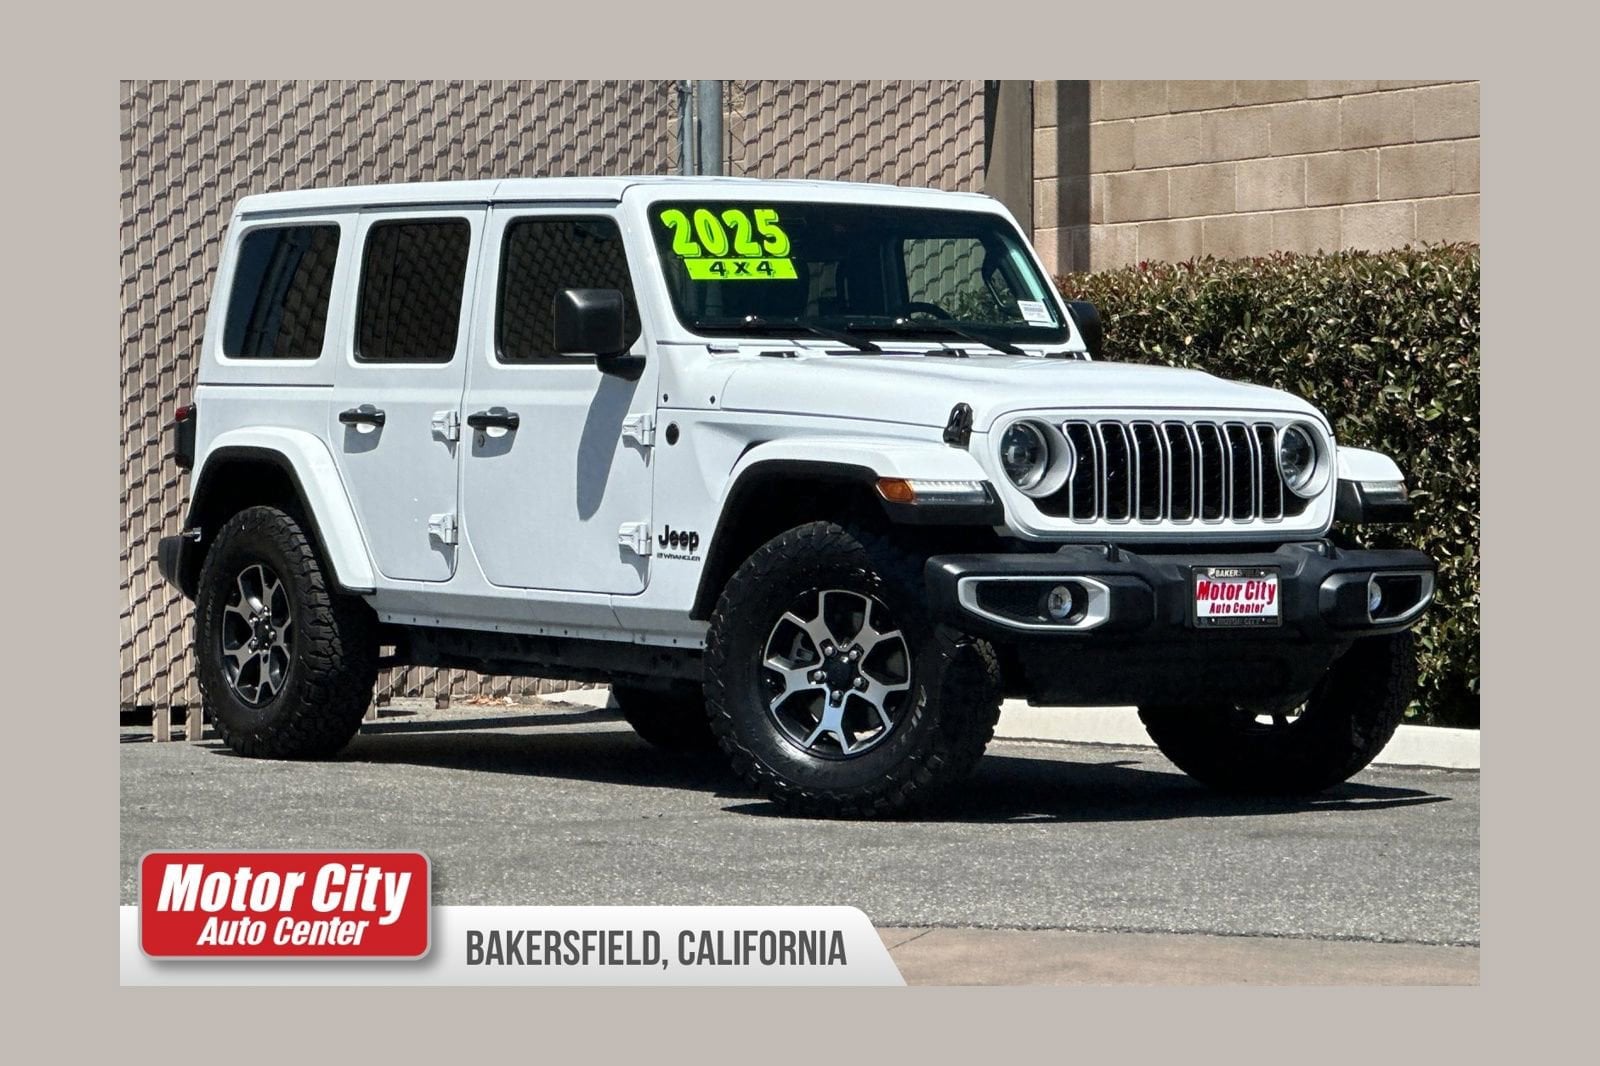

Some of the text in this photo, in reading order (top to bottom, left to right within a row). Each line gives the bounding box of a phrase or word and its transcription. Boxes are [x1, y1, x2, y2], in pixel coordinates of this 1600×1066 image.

[660, 208, 790, 257] 2025
[658, 524, 700, 555] Jeep
[1215, 569, 1261, 578] BAKERS
[1196, 580, 1276, 605] Motor City
[1209, 602, 1265, 614] Auto Center
